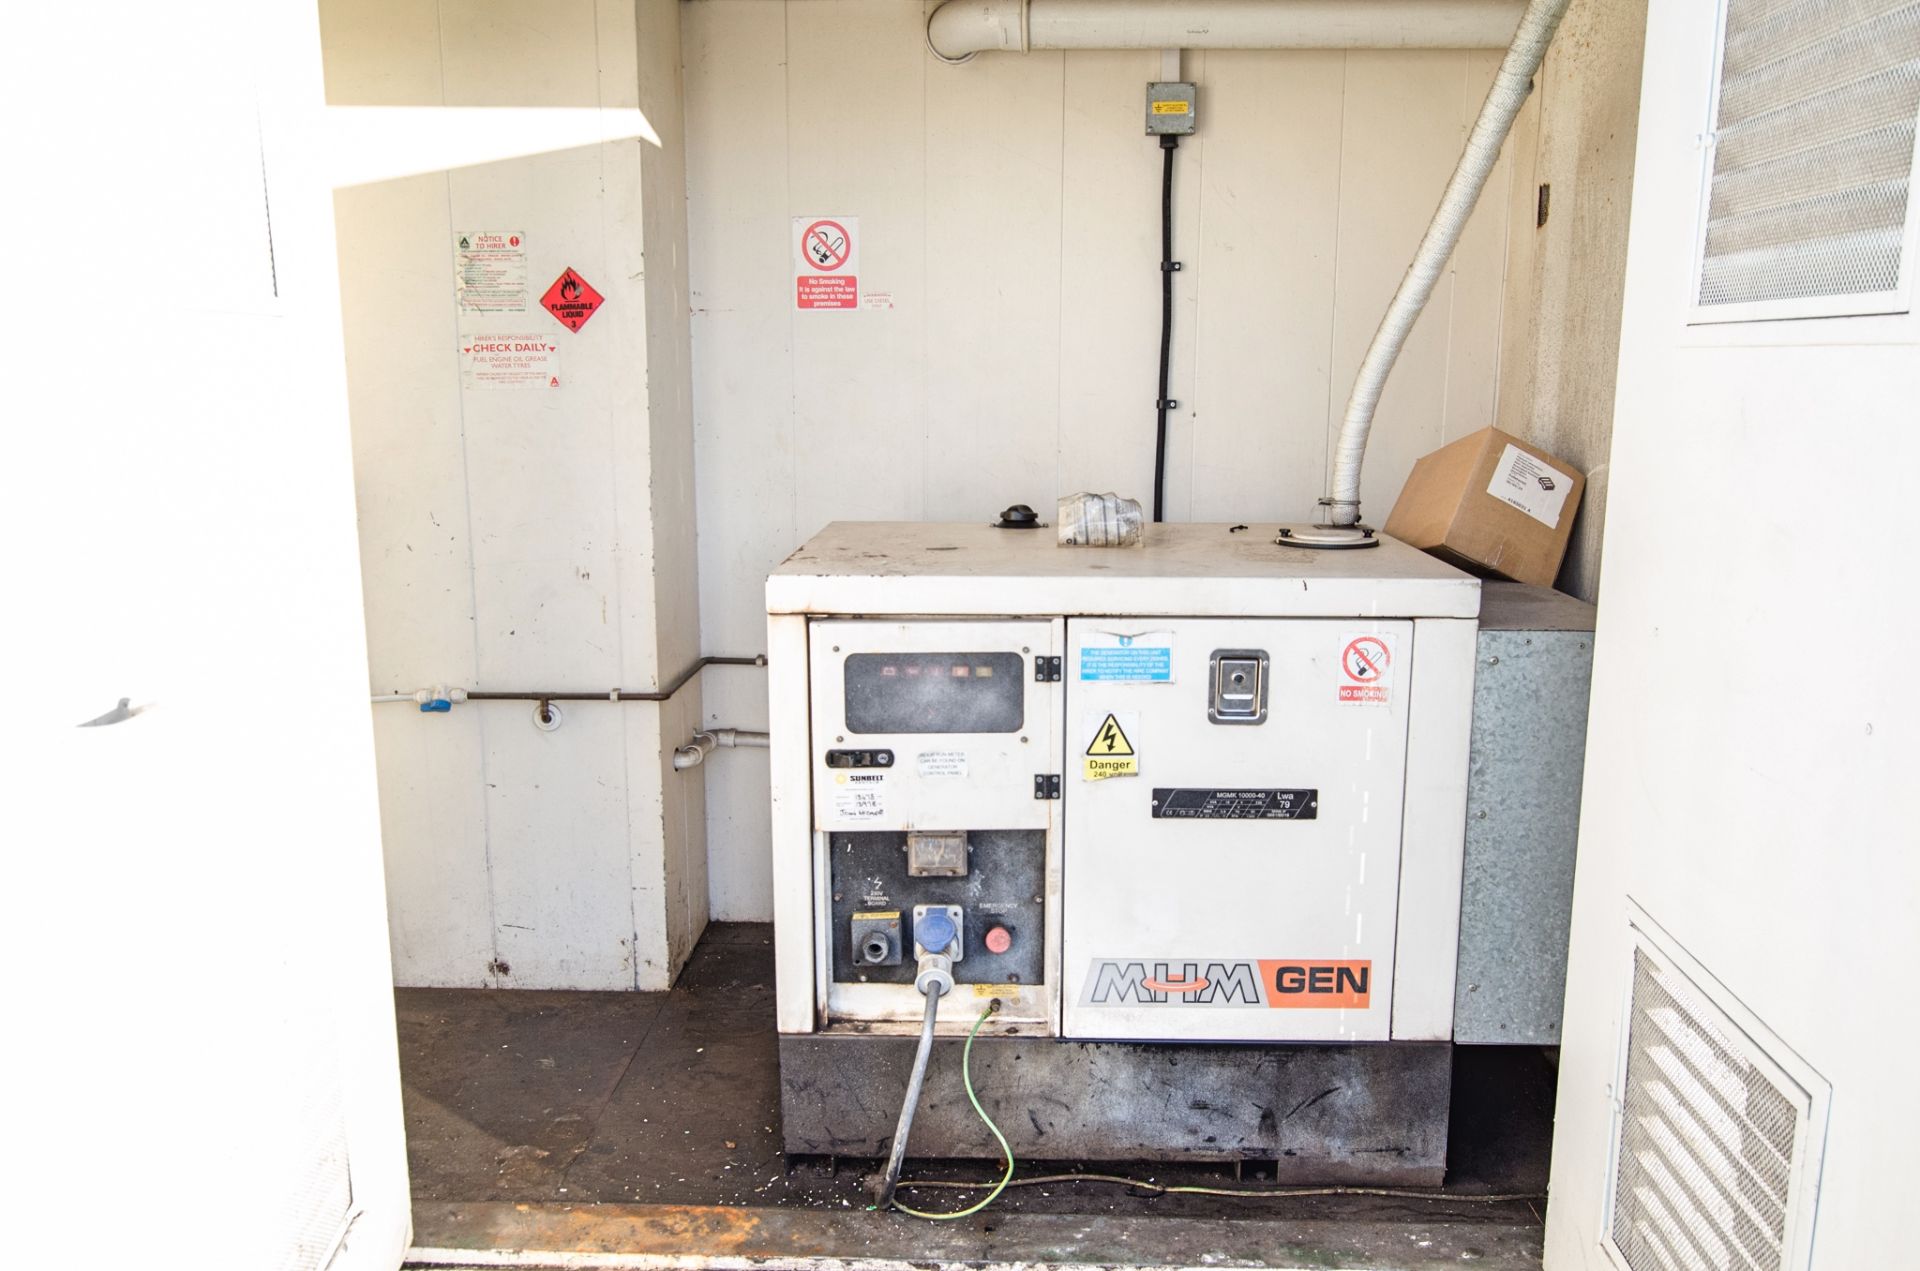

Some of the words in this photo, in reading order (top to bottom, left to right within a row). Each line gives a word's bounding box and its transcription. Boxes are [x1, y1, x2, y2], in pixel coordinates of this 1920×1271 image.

[551, 302, 593, 311] FLAMMABLE
[571, 320, 577, 328] 3
[472, 343, 512, 353] CHECK
[515, 343, 547, 352] DAILY
[1340, 689, 1352, 698] NO
[1089, 760, 1131, 771] Danger
[1277, 791, 1294, 800] Lwa
[1279, 800, 1291, 809] 79
[1090, 963, 1260, 1003] MHM
[1275, 966, 1369, 994] GEN
